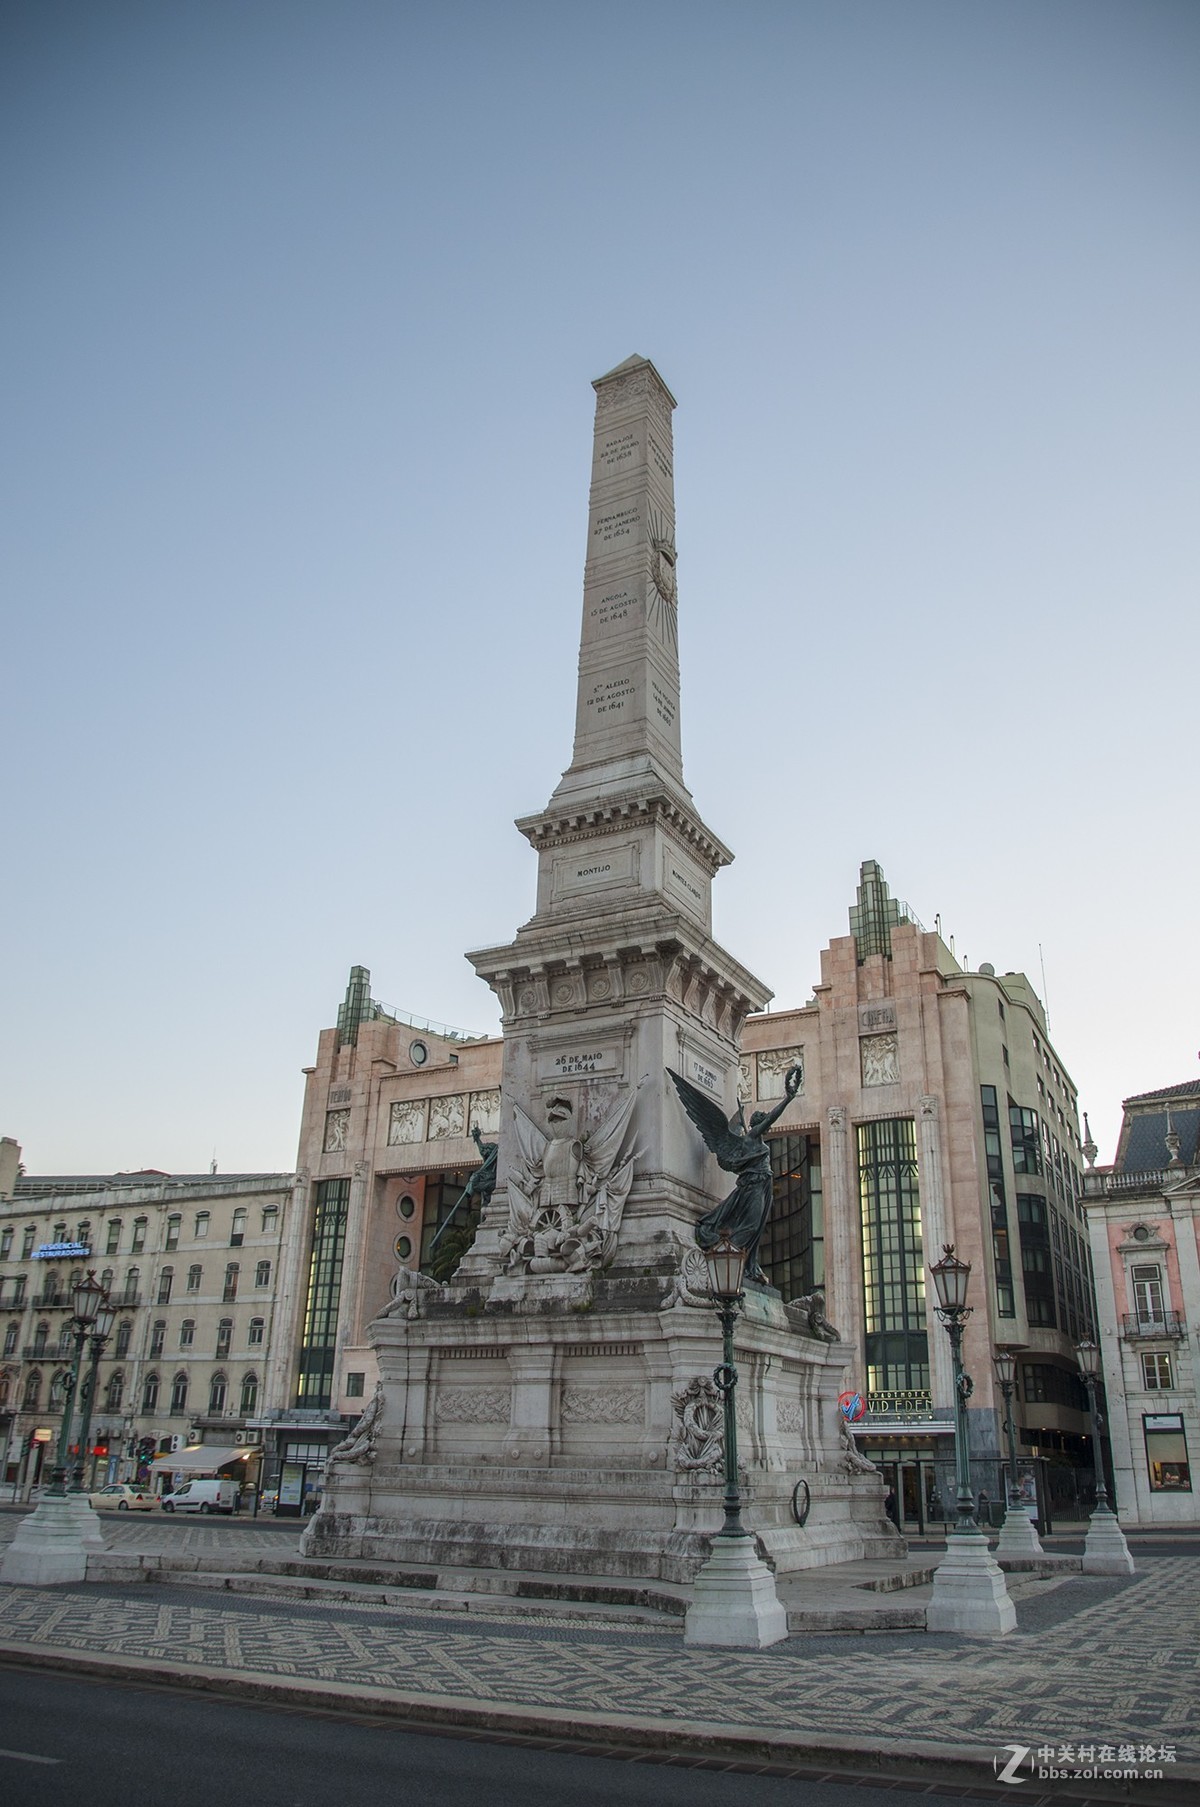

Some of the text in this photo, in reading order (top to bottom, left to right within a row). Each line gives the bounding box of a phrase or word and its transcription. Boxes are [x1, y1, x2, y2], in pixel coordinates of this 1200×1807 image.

[596, 507, 638, 525] PERNAMBUCO
[614, 515, 640, 528] JANEIRO
[601, 592, 627, 604] ANGOLA
[599, 606, 608, 614] DE
[610, 598, 638, 611] AGOSTO
[600, 609, 628, 624] DE 1648
[605, 678, 630, 690] ALEIXO
[595, 695, 605, 704] DE
[606, 687, 636, 700] AGOSTO
[597, 701, 624, 713] DE 1641
[577, 864, 611, 877] MONTIJO
[555, 1054, 566, 1066] 26
[582, 1052, 603, 1062] MAIO
[562, 1060, 595, 1073] DE 1644
[895, 1399, 933, 1413] EDEN
